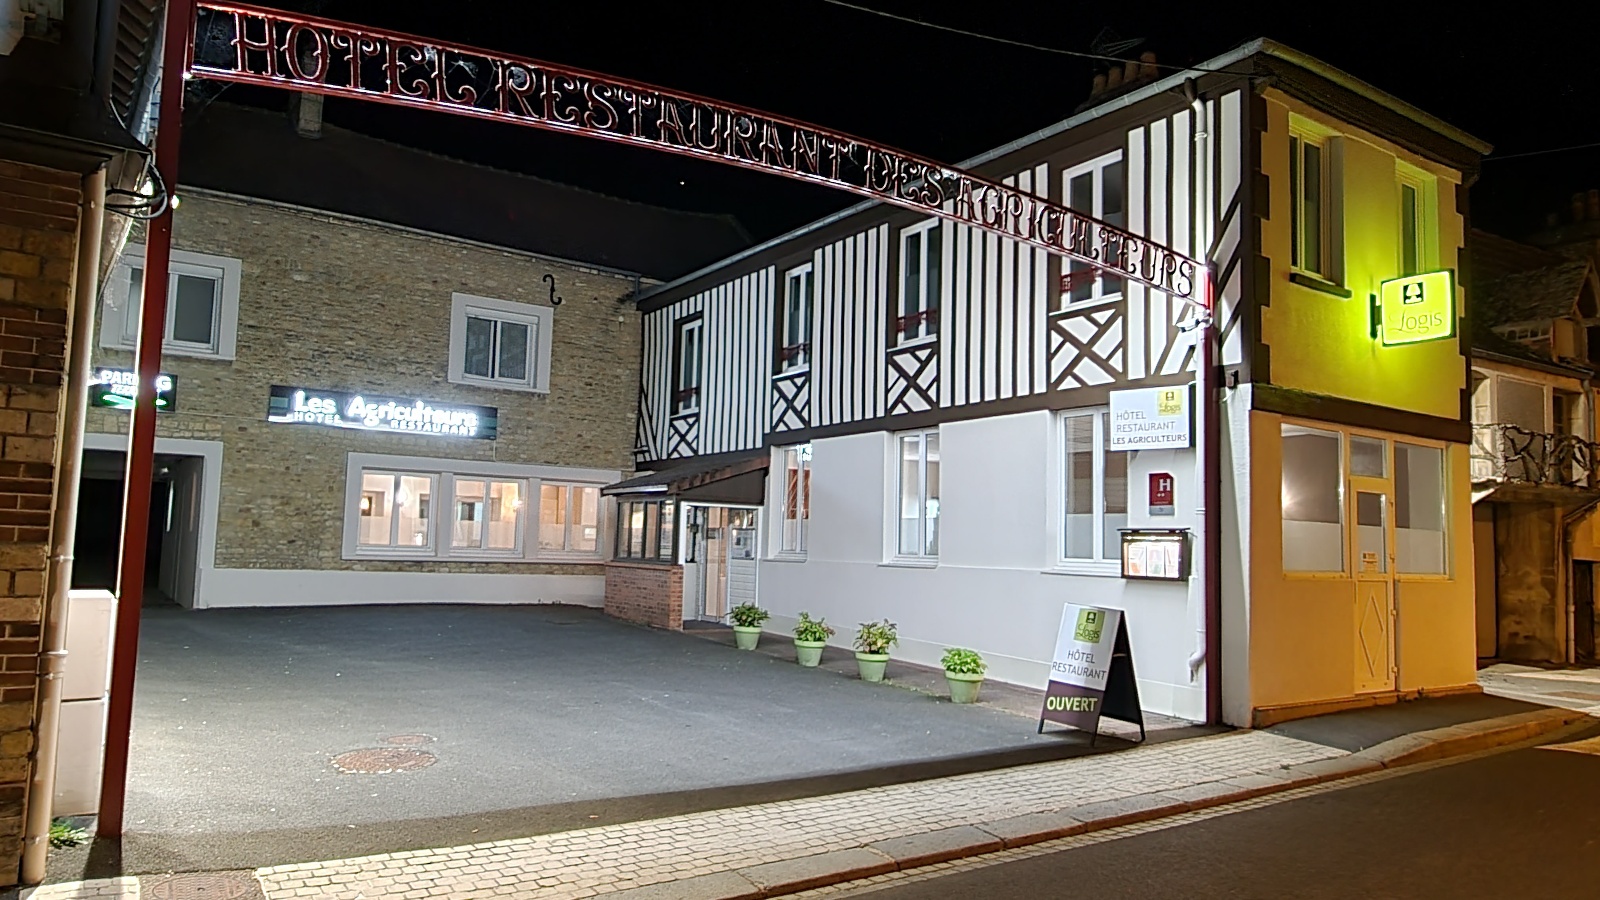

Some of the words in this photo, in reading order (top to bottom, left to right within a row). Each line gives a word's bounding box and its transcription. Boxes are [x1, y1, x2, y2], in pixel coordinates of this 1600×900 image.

[231, 12, 477, 106] HOTEL
[495, 60, 857, 182] RESTAURANT
[864, 148, 945, 206] DES
[956, 178, 1193, 298] AGRICULTEURS
[1388, 309, 1443, 334] Logis
[101, 370, 172, 391] PARG
[294, 390, 337, 415] Les
[348, 395, 478, 427] Agriculteurs
[1116, 410, 1147, 421] HÔTEL
[294, 411, 343, 425] HOTEL
[390, 419, 478, 437] RESTAURANT
[1116, 421, 1176, 433] RESTAURANT
[1112, 437, 1126, 445] LES
[1127, 434, 1187, 444] AGRICULTEURS
[1158, 479, 1171, 492] H
[1075, 622, 1100, 641] Logis
[1067, 648, 1096, 664] HÔTEL
[1051, 661, 1107, 681] RESTAURANT
[1046, 696, 1098, 712] OUVERT
